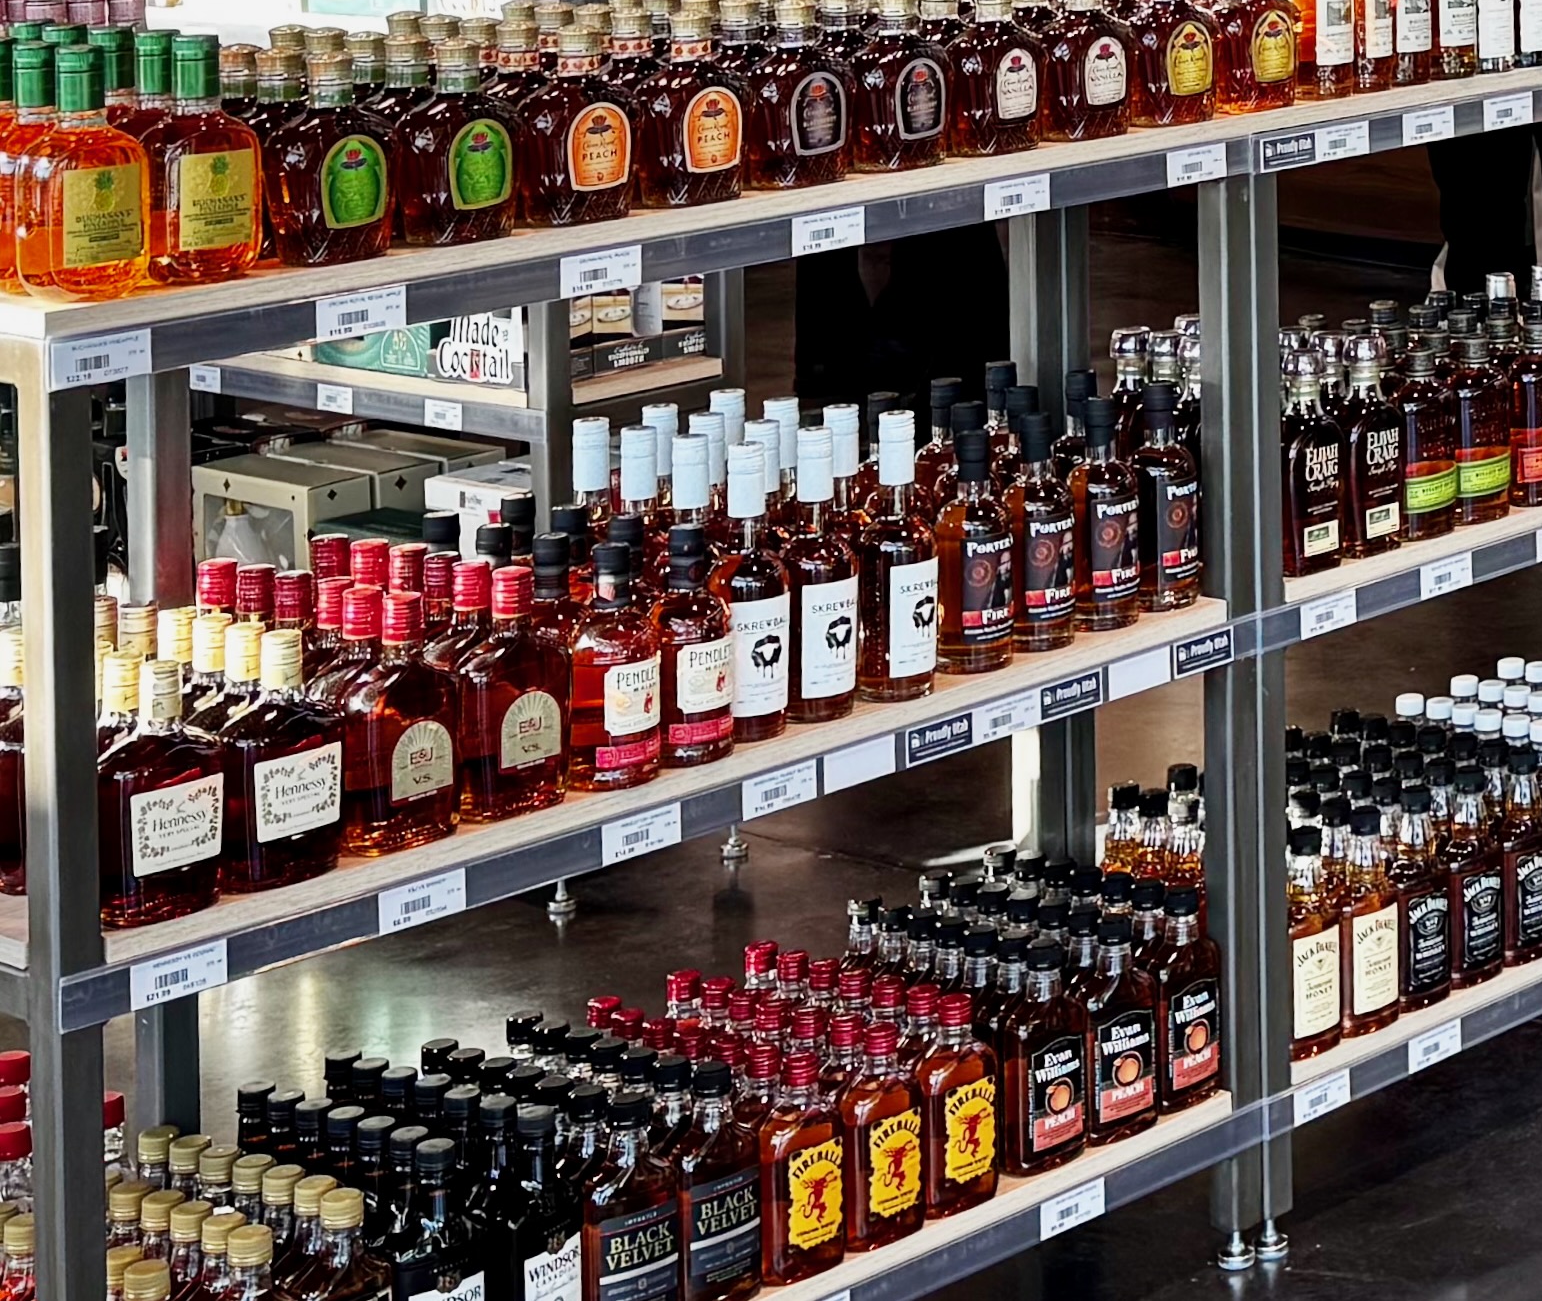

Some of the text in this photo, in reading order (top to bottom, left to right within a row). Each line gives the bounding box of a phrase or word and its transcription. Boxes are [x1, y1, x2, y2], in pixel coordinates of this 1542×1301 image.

[1089, 69, 1123, 83] VANILLA
[1001, 82, 1034, 96] VANILLA
[697, 131, 730, 145] PEACH
[582, 149, 617, 162] PEACH
[440, 341, 509, 379] Cocktail
[1366, 427, 1399, 449] ELIJAH
[1306, 443, 1339, 466] ELIJAH
[1366, 443, 1399, 465] CRAIG
[1305, 460, 1339, 481] CRAIG
[1166, 481, 1198, 500] PORT
[1180, 546, 1198, 563] FIR
[1111, 567, 1140, 585] FIRE
[811, 598, 855, 614] SKREWBA
[1044, 586, 1074, 604] FIRE
[736, 615, 787, 632] SKREWBA
[981, 607, 1011, 625] FIRE
[689, 644, 734, 668] PENDLE
[1190, 635, 1228, 660] Proudly Utah
[616, 665, 657, 690] PENDLE
[1055, 678, 1097, 703] Proudly Utah
[518, 715, 543, 734] E&J
[924, 721, 952, 743] Proudly
[952, 717, 968, 734] Utah
[409, 747, 434, 765] E&J
[275, 778, 327, 799] Hennessy
[152, 809, 207, 832] Hennessy
[1517, 859, 1534, 881] JACK
[1463, 880, 1481, 902] JACK
[1409, 903, 1427, 924] JACK
[1357, 925, 1374, 945] JACK
[1297, 948, 1315, 967] JACK
[1365, 962, 1392, 977] HONEY
[1182, 991, 1209, 1009] Evan
[1306, 985, 1333, 1000] HONEY
[1174, 1000, 1216, 1024] Williams
[1111, 1023, 1142, 1040] Evan
[1101, 1032, 1150, 1056] Williams
[1044, 1049, 1073, 1067] Evan
[1183, 1047, 1212, 1069] PEACH
[1034, 1059, 1081, 1083] Williams
[948, 1086, 995, 1116] FIREBALL
[1112, 1081, 1145, 1101] PEACH
[1044, 1108, 1076, 1130] PEACH
[873, 1119, 920, 1149] FIREBALL
[792, 1150, 842, 1179] FIREBALL
[700, 1185, 754, 1220] BLACK
[696, 1200, 758, 1236] VELVET
[609, 1220, 672, 1254] BLACK
[528, 1245, 582, 1282] WINDSOR
[605, 1236, 674, 1271] VELVET
